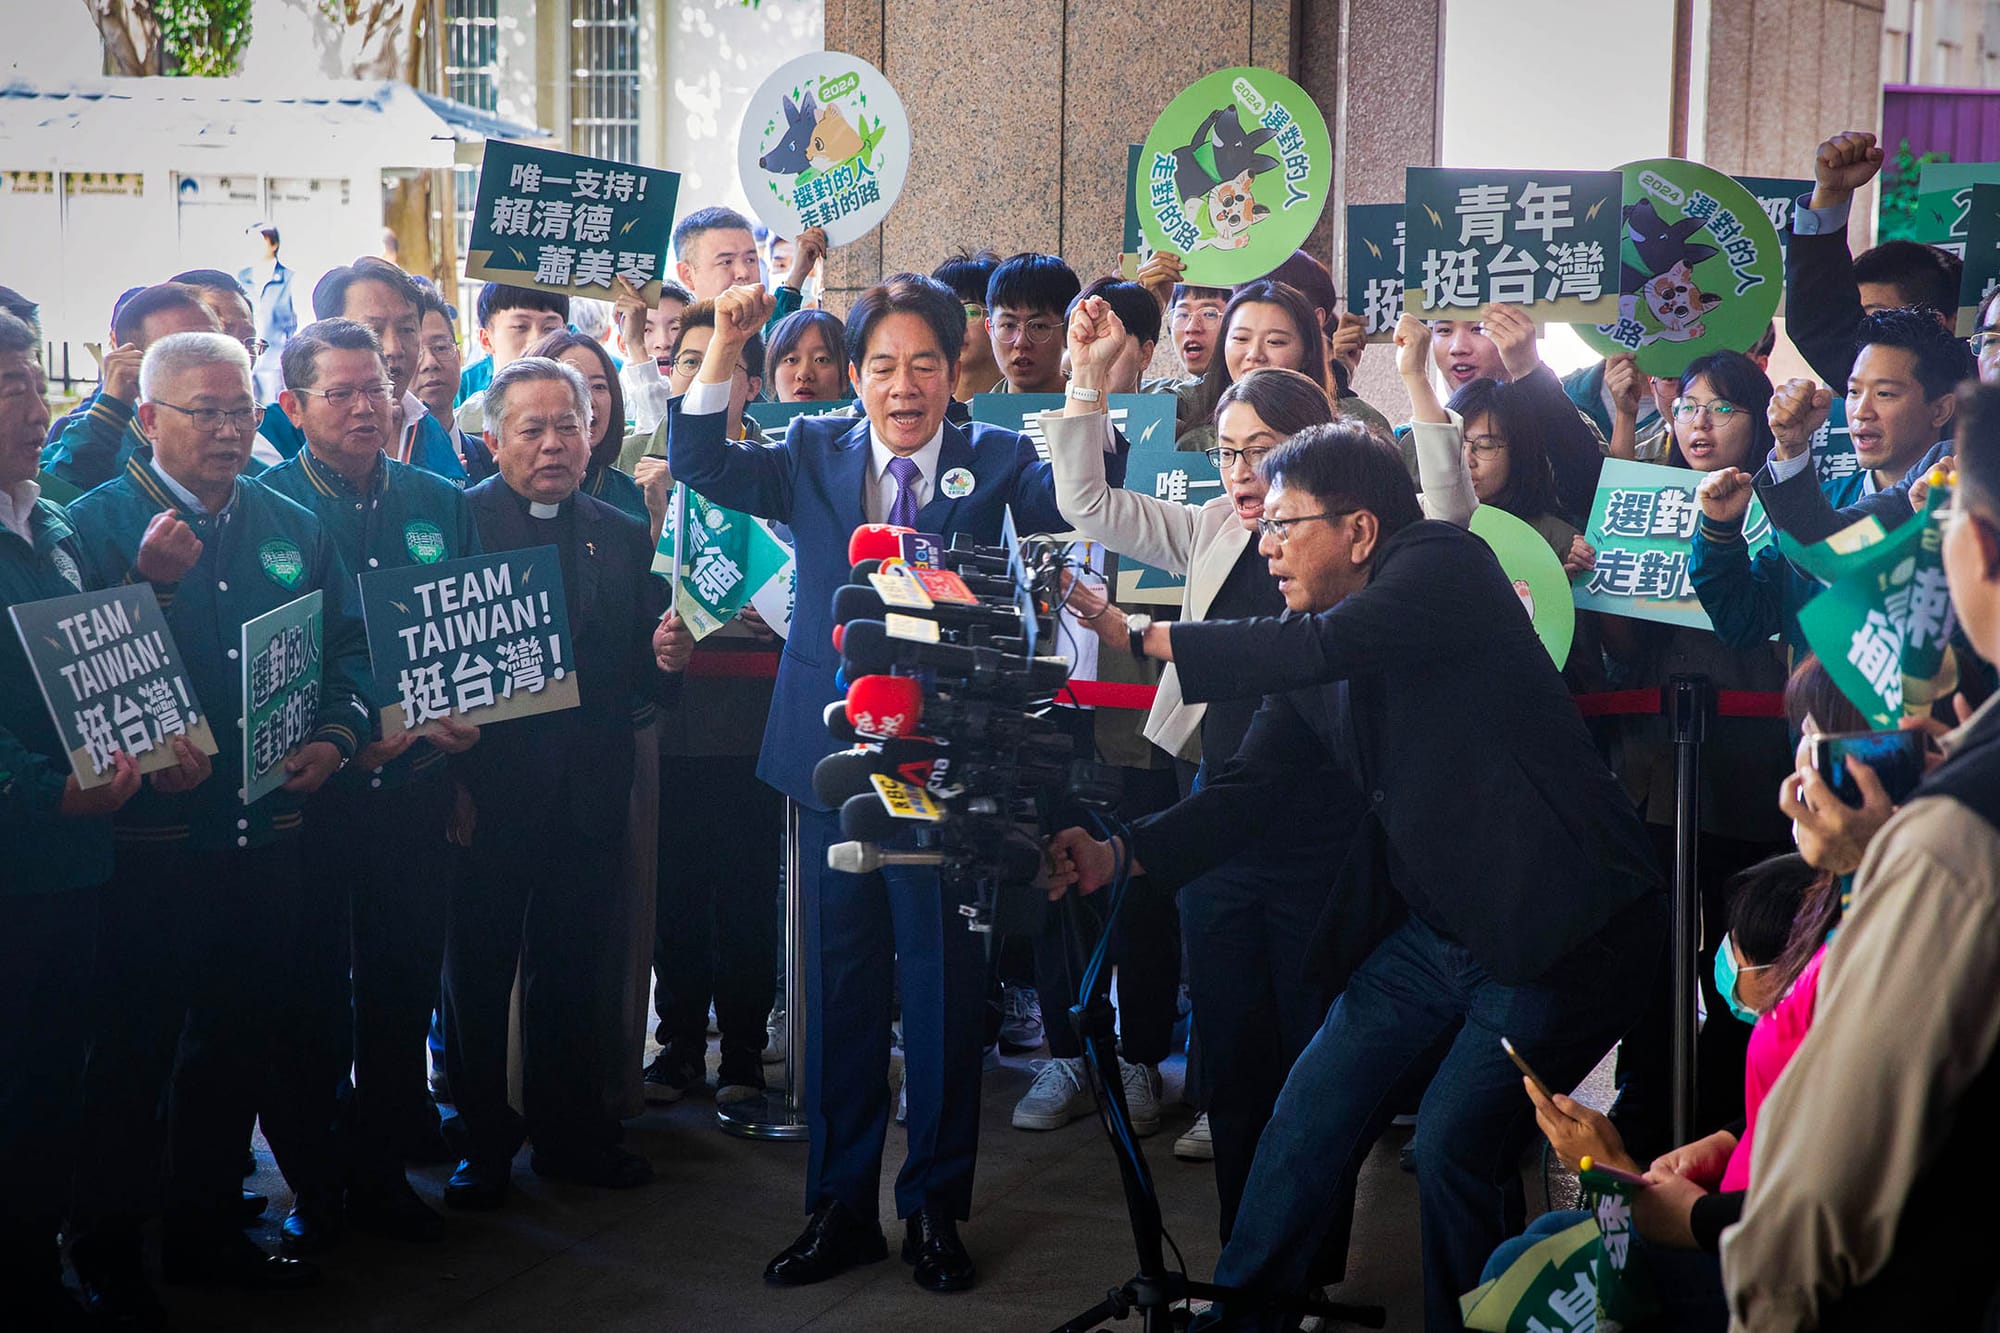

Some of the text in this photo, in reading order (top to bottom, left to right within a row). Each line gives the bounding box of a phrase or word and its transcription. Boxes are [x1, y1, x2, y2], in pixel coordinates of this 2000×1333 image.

[822, 75, 856, 100] 2024
[1234, 80, 1261, 112] 2024
[510, 163, 648, 202] 唯一支持!
[793, 158, 874, 211] 選對的人
[1261, 103, 1310, 209] 選對的人
[1642, 173, 1681, 202] 2024
[490, 196, 614, 243] 賴清德
[1151, 153, 1200, 252] 走對的路
[1455, 181, 1575, 246] 青年
[534, 245, 656, 290] 蕭美琴
[1421, 241, 1605, 310] 挺台灣
[1682, 190, 1764, 295] 選對的人
[413, 563, 512, 618] TEAM
[57, 600, 133, 656] TEAM
[398, 591, 551, 661] TAIWAN!
[59, 630, 170, 701] TAIWAN!
[251, 614, 319, 712] 選對的人
[398, 633, 565, 729] 挺台灣!
[74, 676, 198, 775] 挺台灣!
[253, 680, 319, 781] 走對的路
